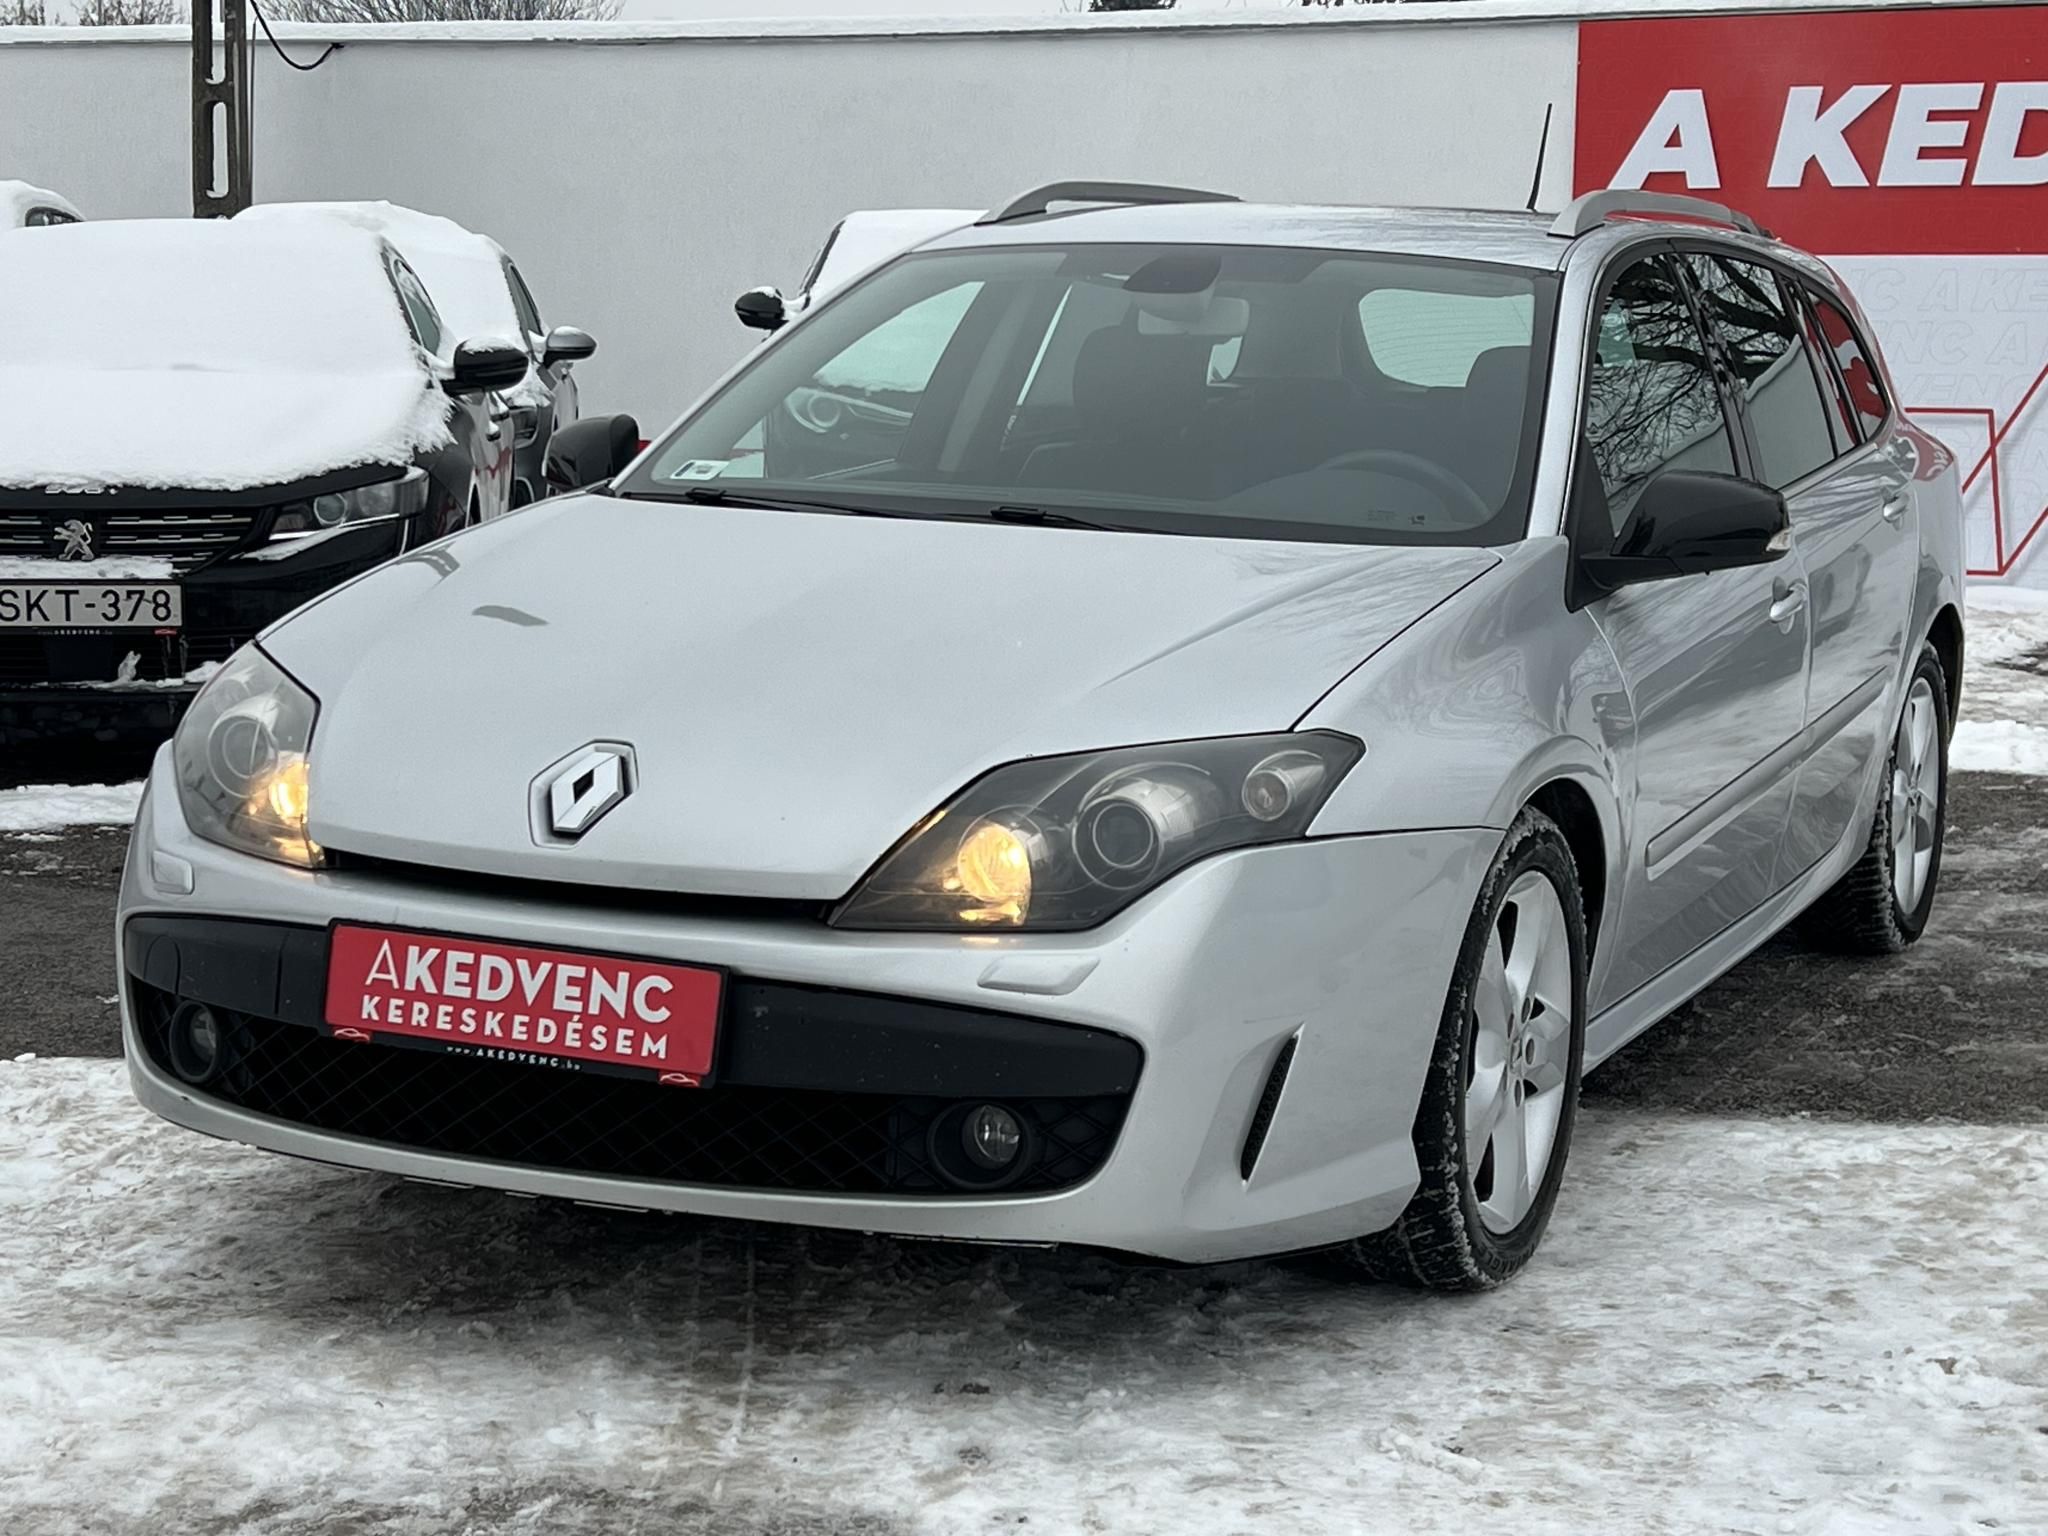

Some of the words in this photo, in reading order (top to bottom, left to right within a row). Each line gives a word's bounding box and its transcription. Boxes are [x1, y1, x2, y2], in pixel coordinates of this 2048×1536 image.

[1605, 88, 1721, 190] A
[1766, 82, 2048, 188] KED
[0, 589, 172, 622] SKT-378
[361, 994, 667, 1060] KERESKEDÉSEM
